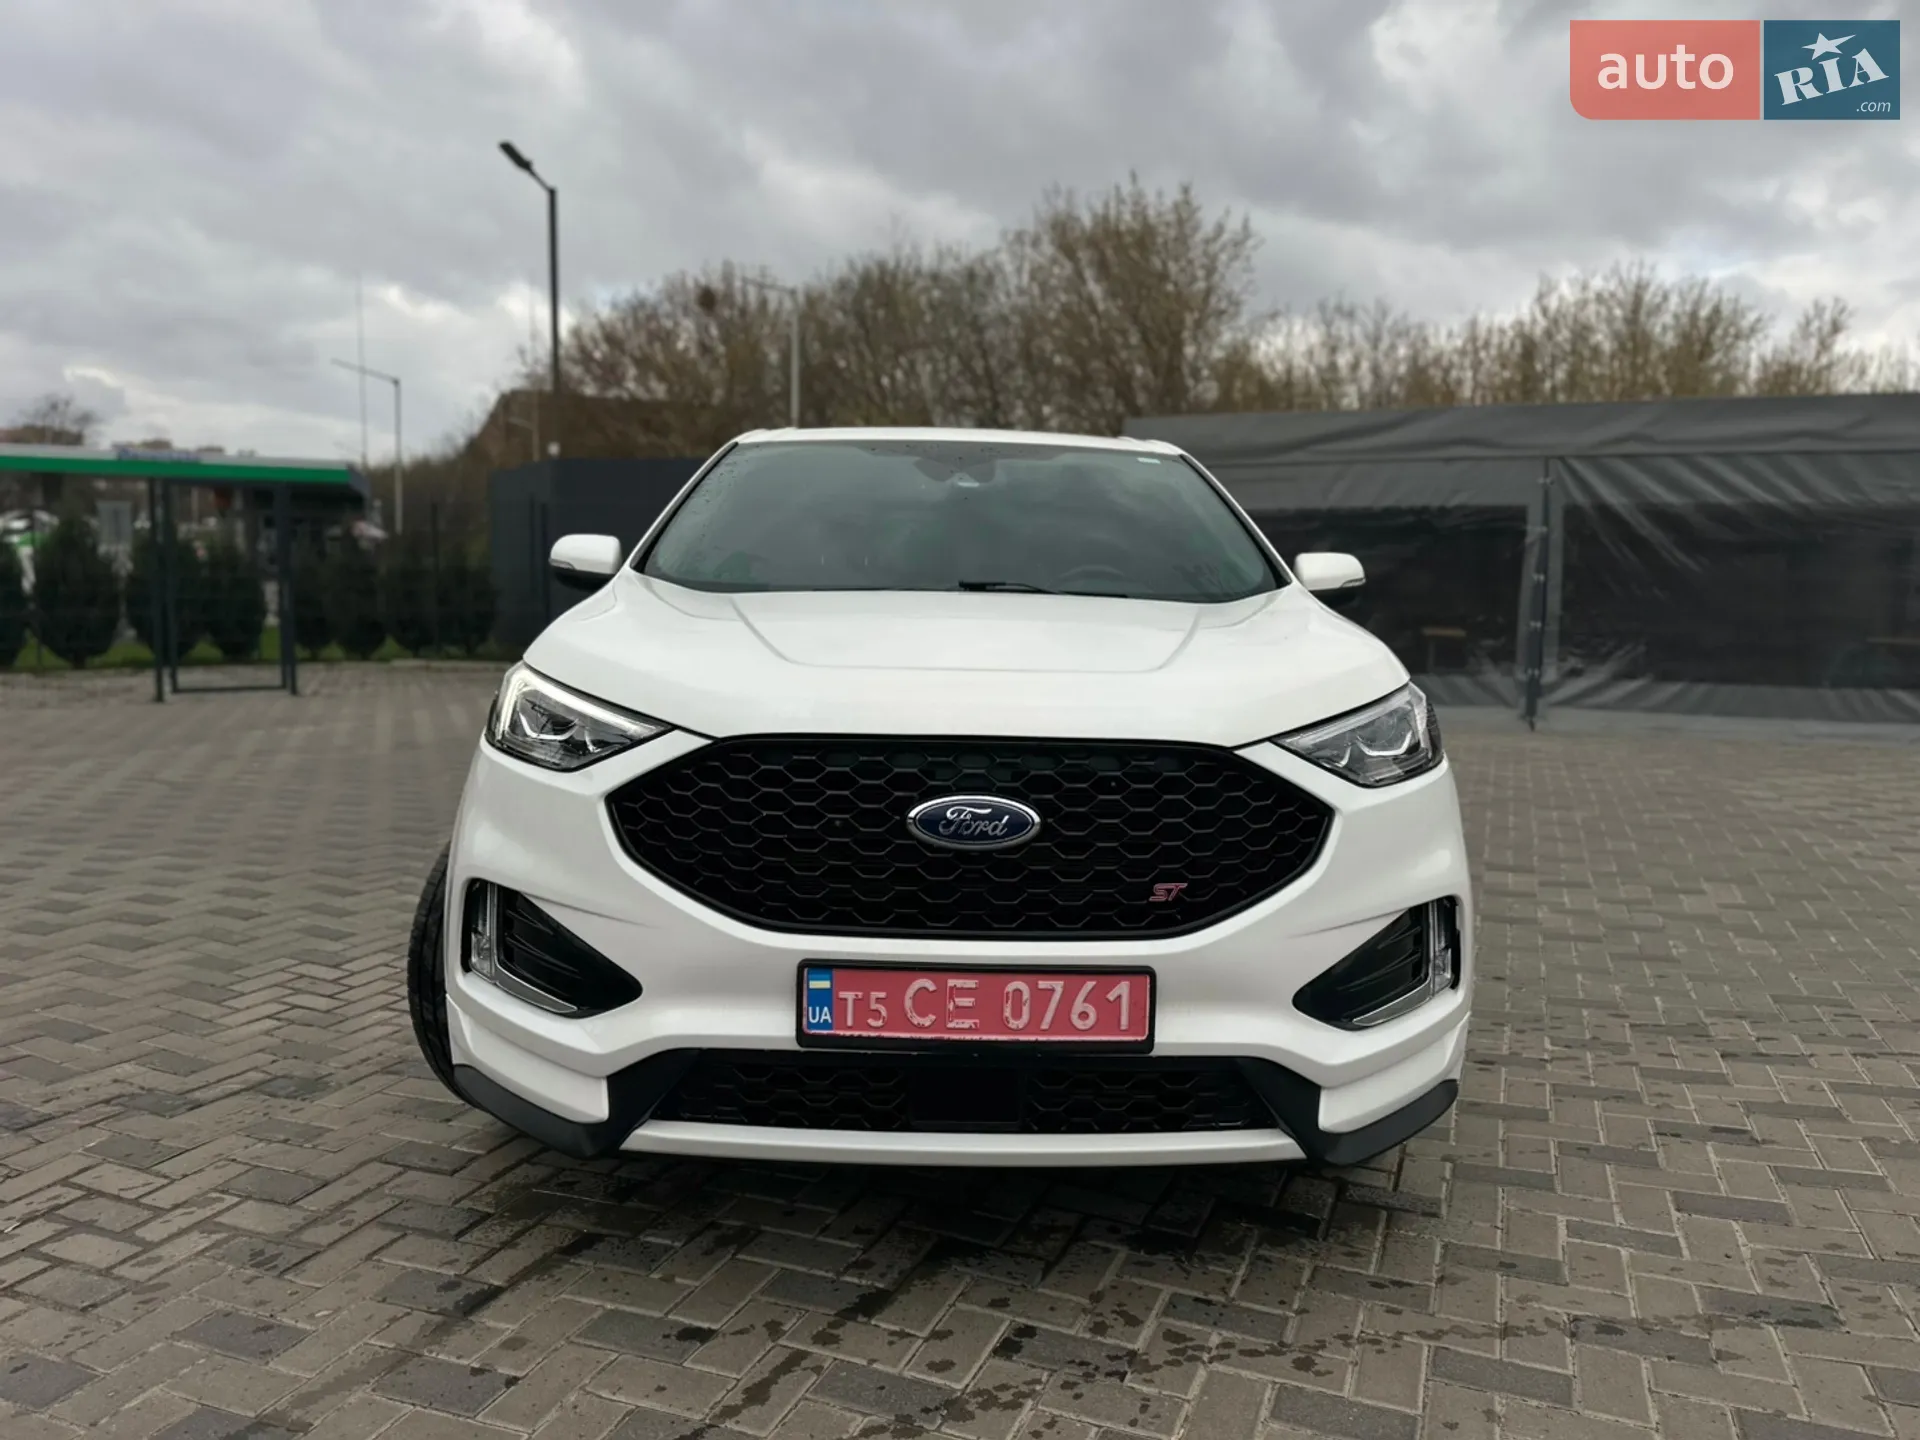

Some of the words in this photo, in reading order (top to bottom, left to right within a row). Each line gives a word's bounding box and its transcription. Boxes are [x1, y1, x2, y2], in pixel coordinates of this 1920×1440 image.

[938, 806, 1010, 836] Ford
[1148, 882, 1188, 902] ST
[808, 1006, 832, 1024] UA
[838, 991, 887, 1027] T5
[903, 978, 979, 1030] CE
[1003, 980, 1130, 1030] 0761
